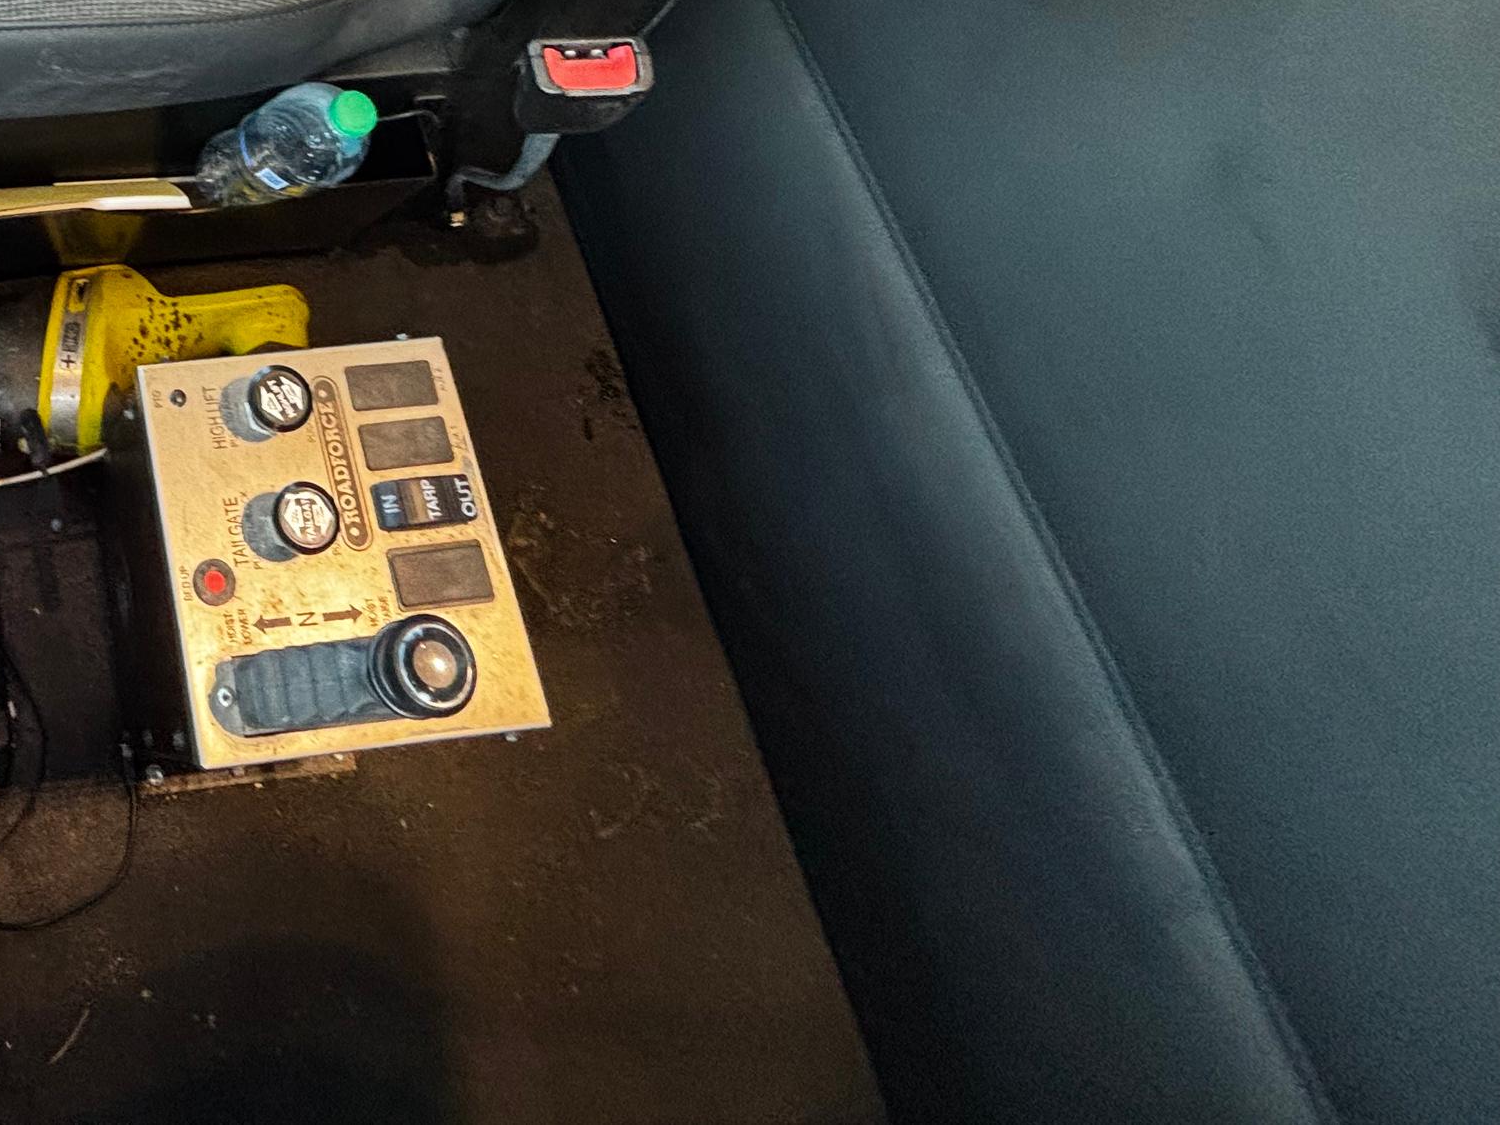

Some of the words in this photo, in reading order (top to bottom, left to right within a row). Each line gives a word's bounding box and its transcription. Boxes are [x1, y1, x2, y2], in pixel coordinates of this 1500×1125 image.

[208, 415, 228, 450] HIGH
[317, 401, 361, 525] ROADFORCE
[380, 494, 401, 514] IN
[420, 479, 443, 521] TARP
[454, 477, 477, 517] OUT
[223, 496, 249, 567] TAILGATE
[296, 611, 319, 626] N
